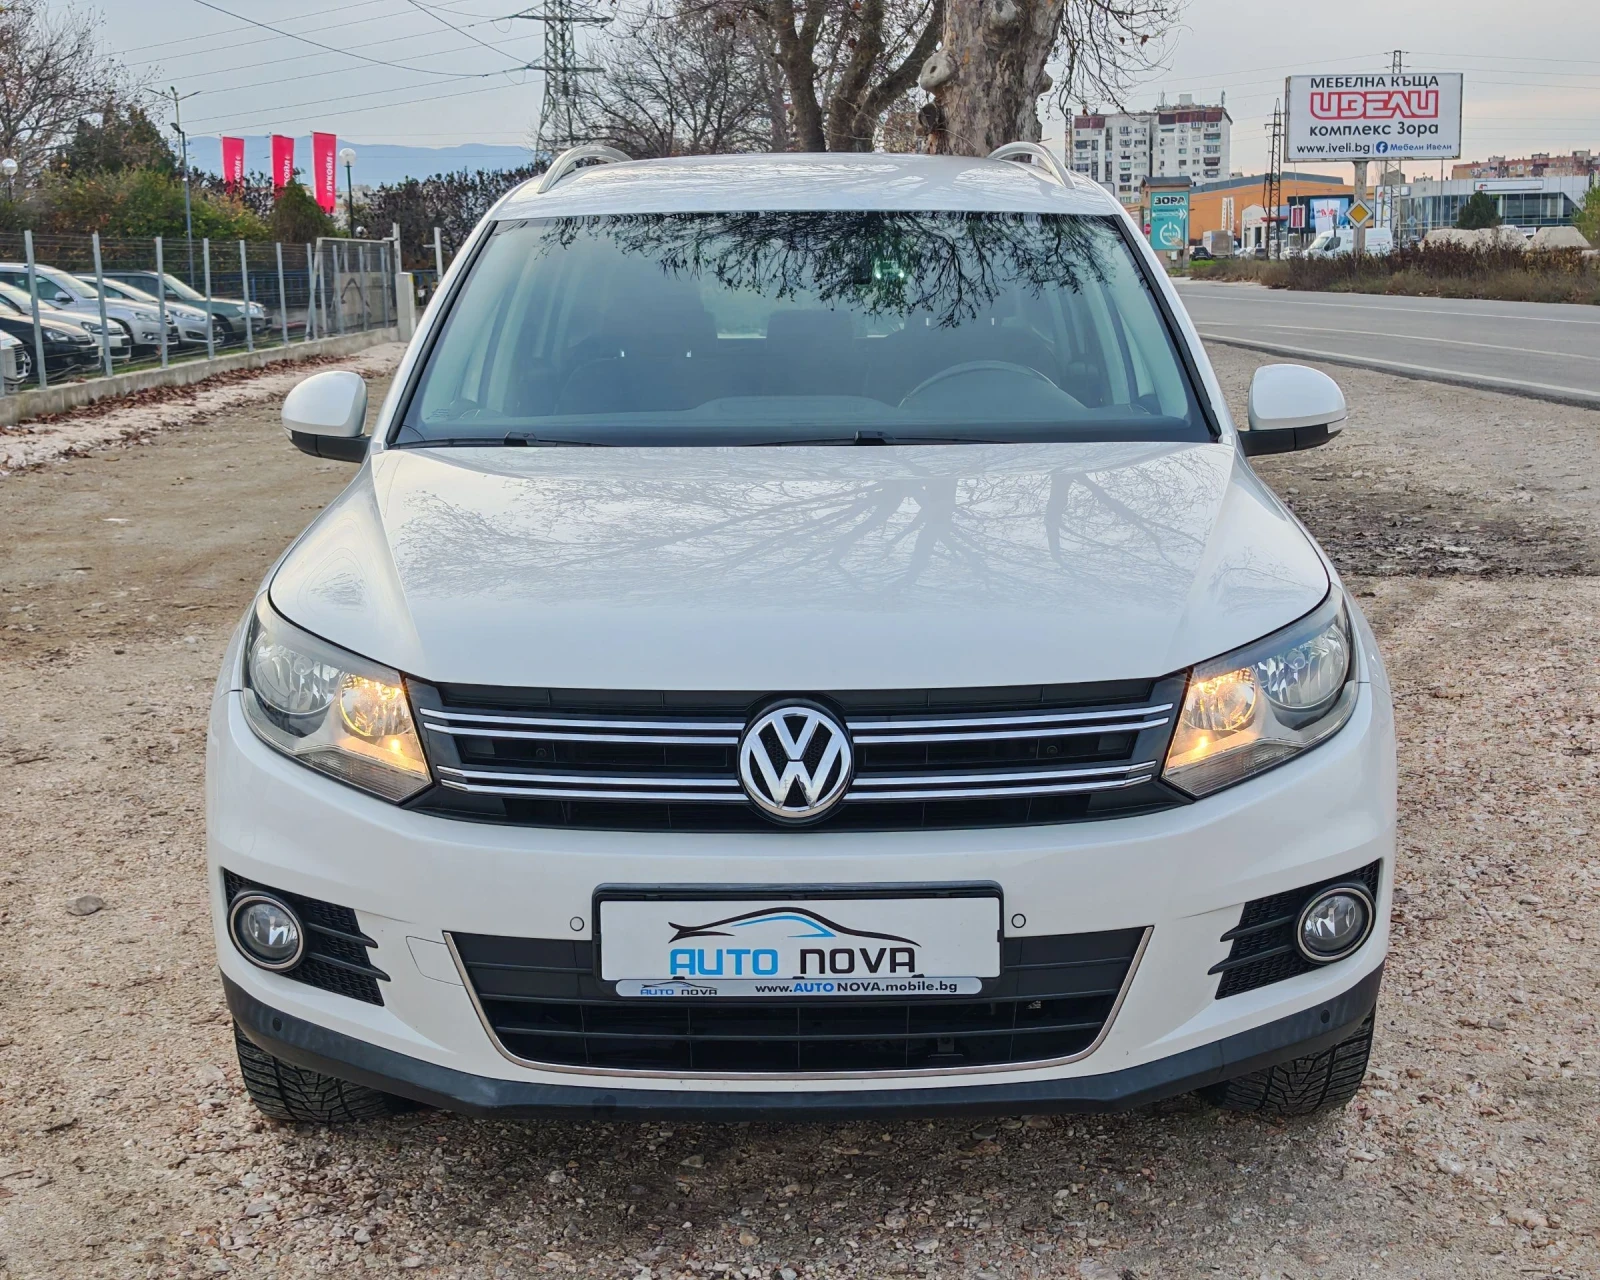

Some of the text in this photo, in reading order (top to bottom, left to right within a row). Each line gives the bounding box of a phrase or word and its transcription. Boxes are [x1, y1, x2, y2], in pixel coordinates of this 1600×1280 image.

[1310, 75, 1439, 89] МЕБЕЛНА КЪЩА
[1310, 89, 1439, 121] ИВЕЛИ
[1309, 121, 1439, 138] комплекс Зора
[1296, 142, 1371, 155] www.iveli.bg
[1390, 143, 1452, 151] Мебели Ивели
[1154, 196, 1186, 205] ЗОРА
[669, 947, 916, 976] AUTO NOVA
[640, 988, 718, 996] AUTO NOVA
